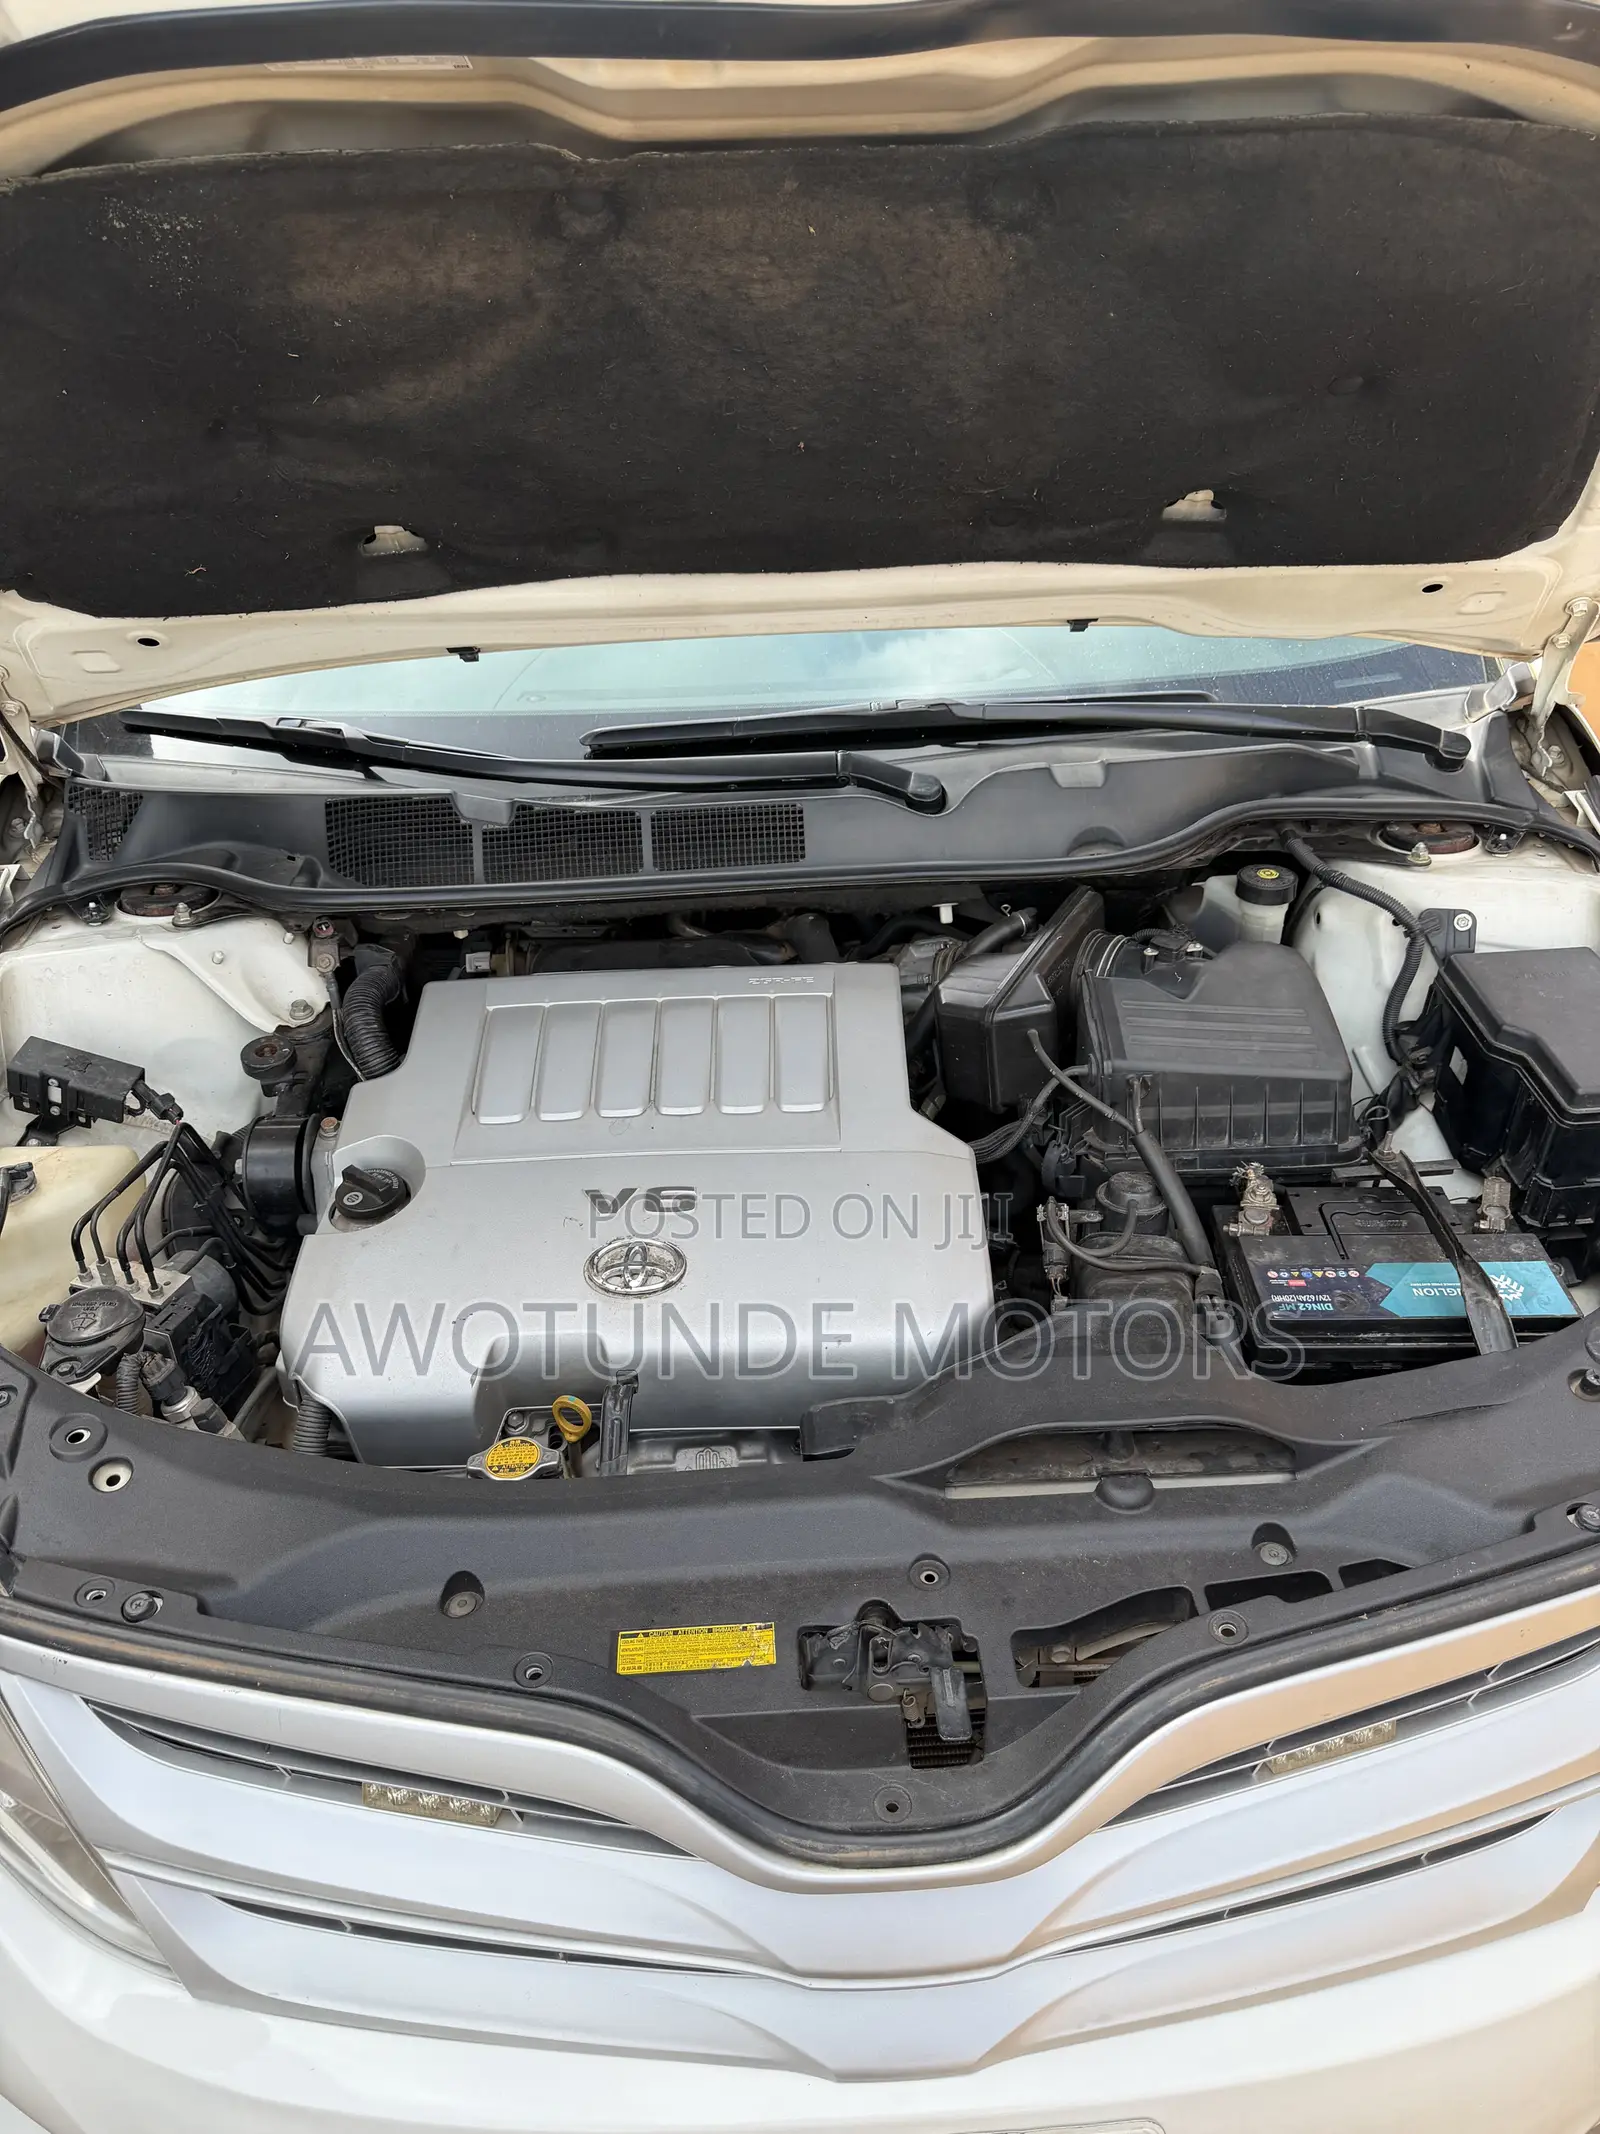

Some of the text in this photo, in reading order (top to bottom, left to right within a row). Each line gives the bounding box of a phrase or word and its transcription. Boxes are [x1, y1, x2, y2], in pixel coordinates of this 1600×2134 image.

[583, 1185, 698, 1214] V6
[1298, 1303, 1334, 1311] DIN62
[648, 1627, 709, 1638] CAUTION ATTENTION
